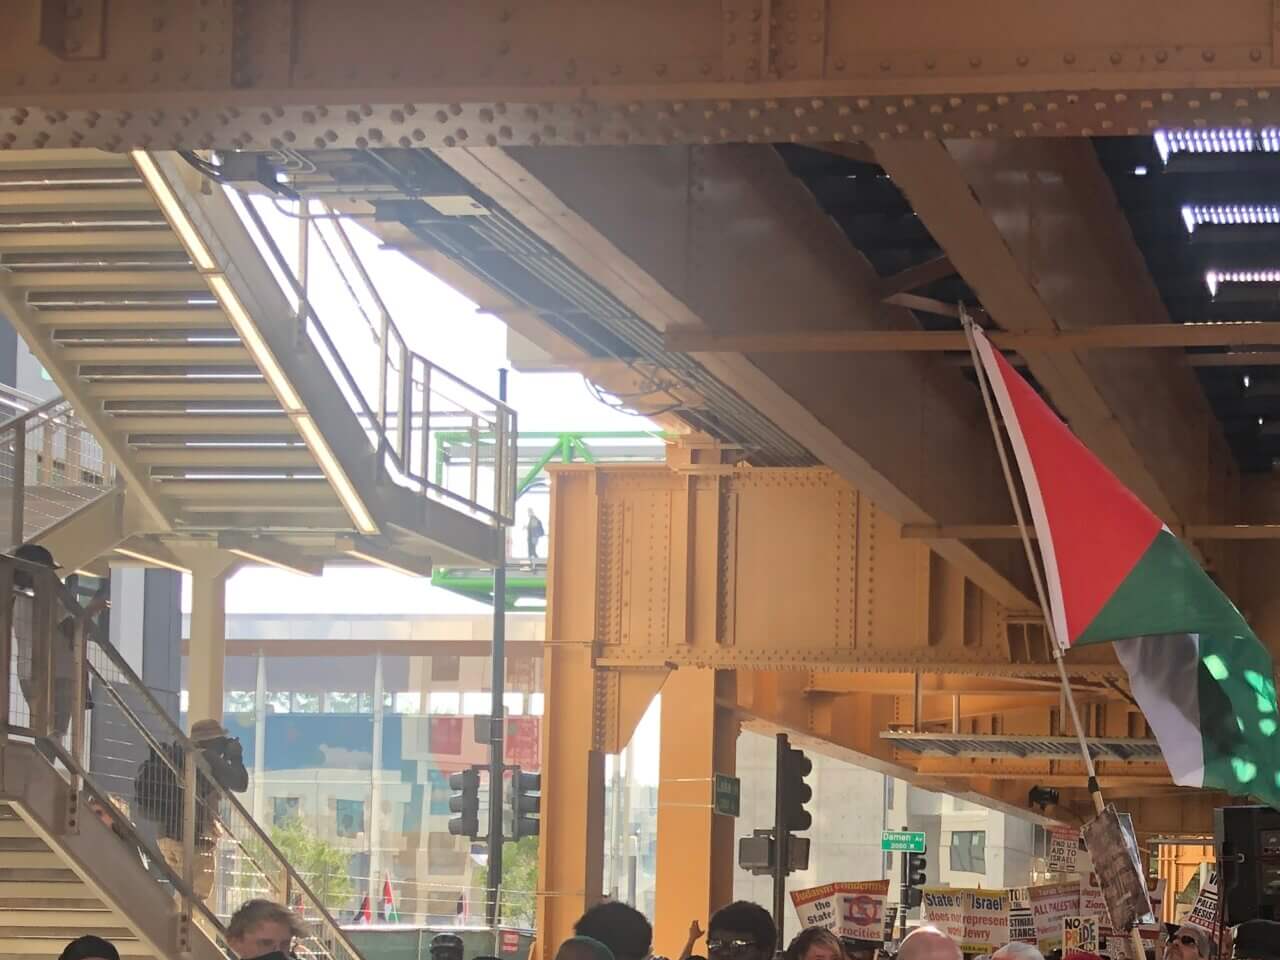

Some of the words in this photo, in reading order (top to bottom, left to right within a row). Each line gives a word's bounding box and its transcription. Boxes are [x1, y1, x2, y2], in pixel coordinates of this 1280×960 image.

[883, 832, 911, 841] Damen
[1067, 849, 1077, 857] TO
[926, 892, 954, 907] State
[814, 901, 832, 912] the
[1033, 902, 1048, 916] ALL
[962, 914, 1009, 927] represent
[1064, 918, 1081, 929] NO
[962, 926, 991, 941] Jewry
[1064, 921, 1096, 946] PRIDE
